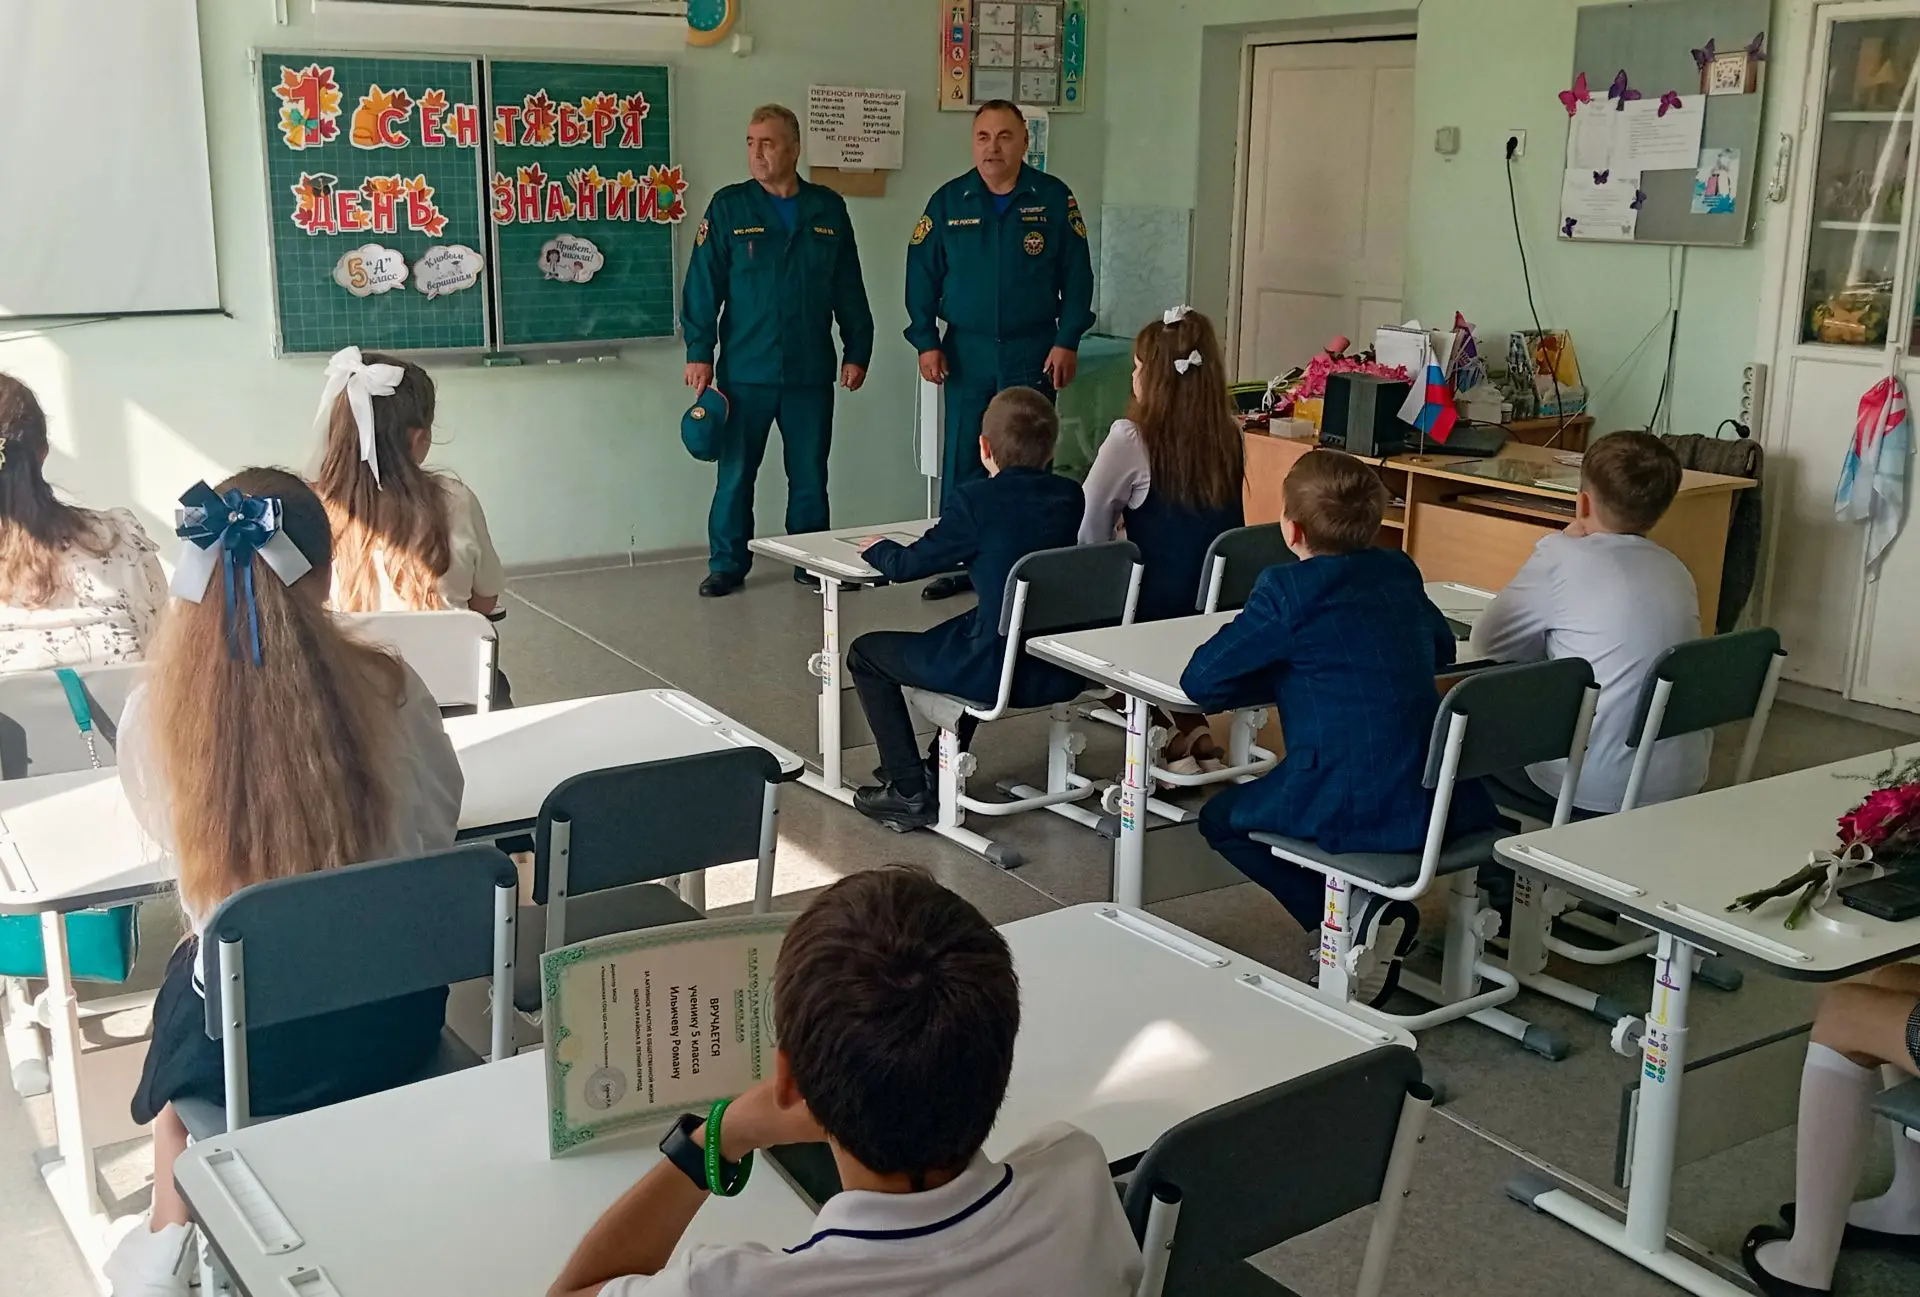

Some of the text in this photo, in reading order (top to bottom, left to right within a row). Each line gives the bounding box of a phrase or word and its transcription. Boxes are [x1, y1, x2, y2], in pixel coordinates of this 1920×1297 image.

[811, 89, 901, 100] ПЕРЕНОСИ ПРАВИЛЬНО
[376, 103, 644, 149] СЕНТЯБРЯ
[810, 111, 845, 119] подъ-езд
[837, 135, 880, 143] ПЕРЕНОСИ
[306, 182, 662, 235] ДЕНЬ ЗНАНИЙ
[348, 257, 368, 288] 5
[369, 273, 399, 286] класс
[426, 272, 473, 292] вершинам
[670, 986, 681, 1080] Ильичеву Роману
[688, 985, 701, 1075] ученику 5 класса
[709, 998, 721, 1057] ВРУЧАЕТСЯ
[635, 1046, 643, 1068] ЛЕТНИЙ
[646, 1038, 654, 1083] ОБЩЕСТВЕННОЙ
